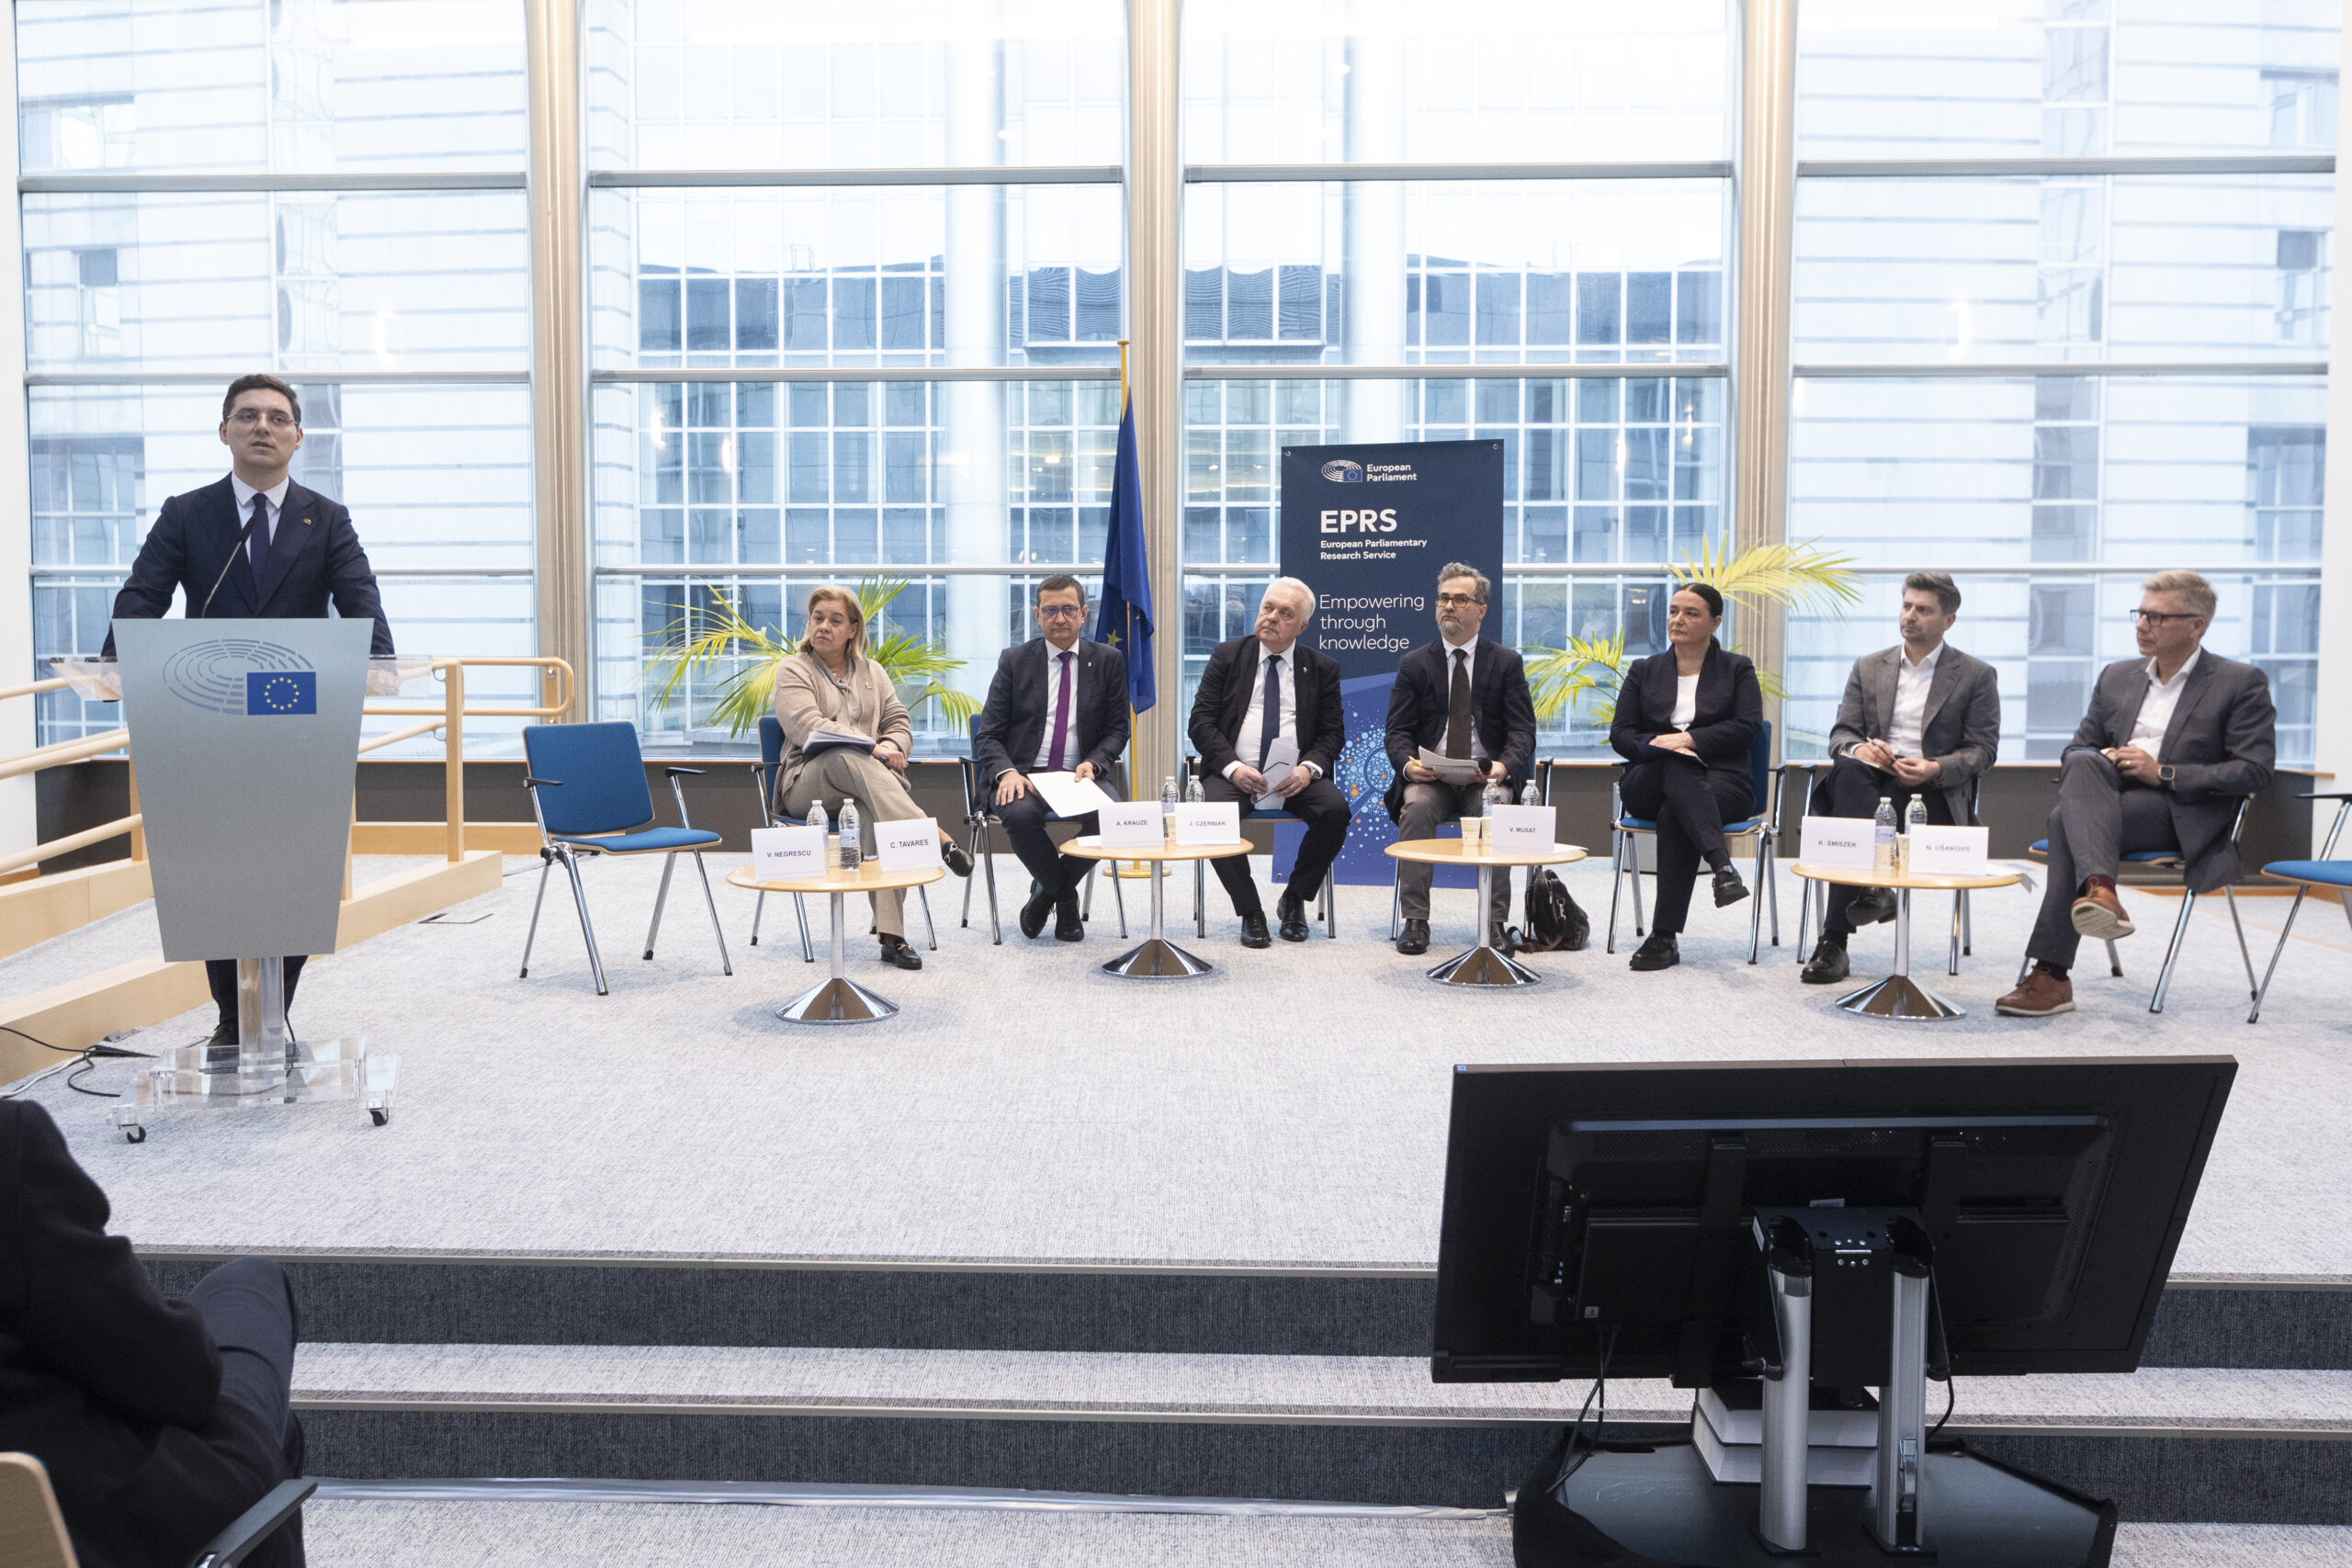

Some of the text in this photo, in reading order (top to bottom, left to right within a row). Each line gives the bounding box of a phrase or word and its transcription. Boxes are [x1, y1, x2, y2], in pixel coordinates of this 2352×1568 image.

[1366, 463, 1411, 473] European
[1366, 472, 1418, 482] Parliament
[1320, 508, 1397, 534] EPRS
[1320, 538, 1428, 550] European Parliamentary
[1320, 550, 1396, 560] Research Service
[1319, 593, 1425, 612] Empowering
[1320, 614, 1386, 633] through
[1318, 634, 1410, 652] knowledge
[899, 839, 930, 848] TAVARES
[774, 850, 812, 858] NEGRESCU
